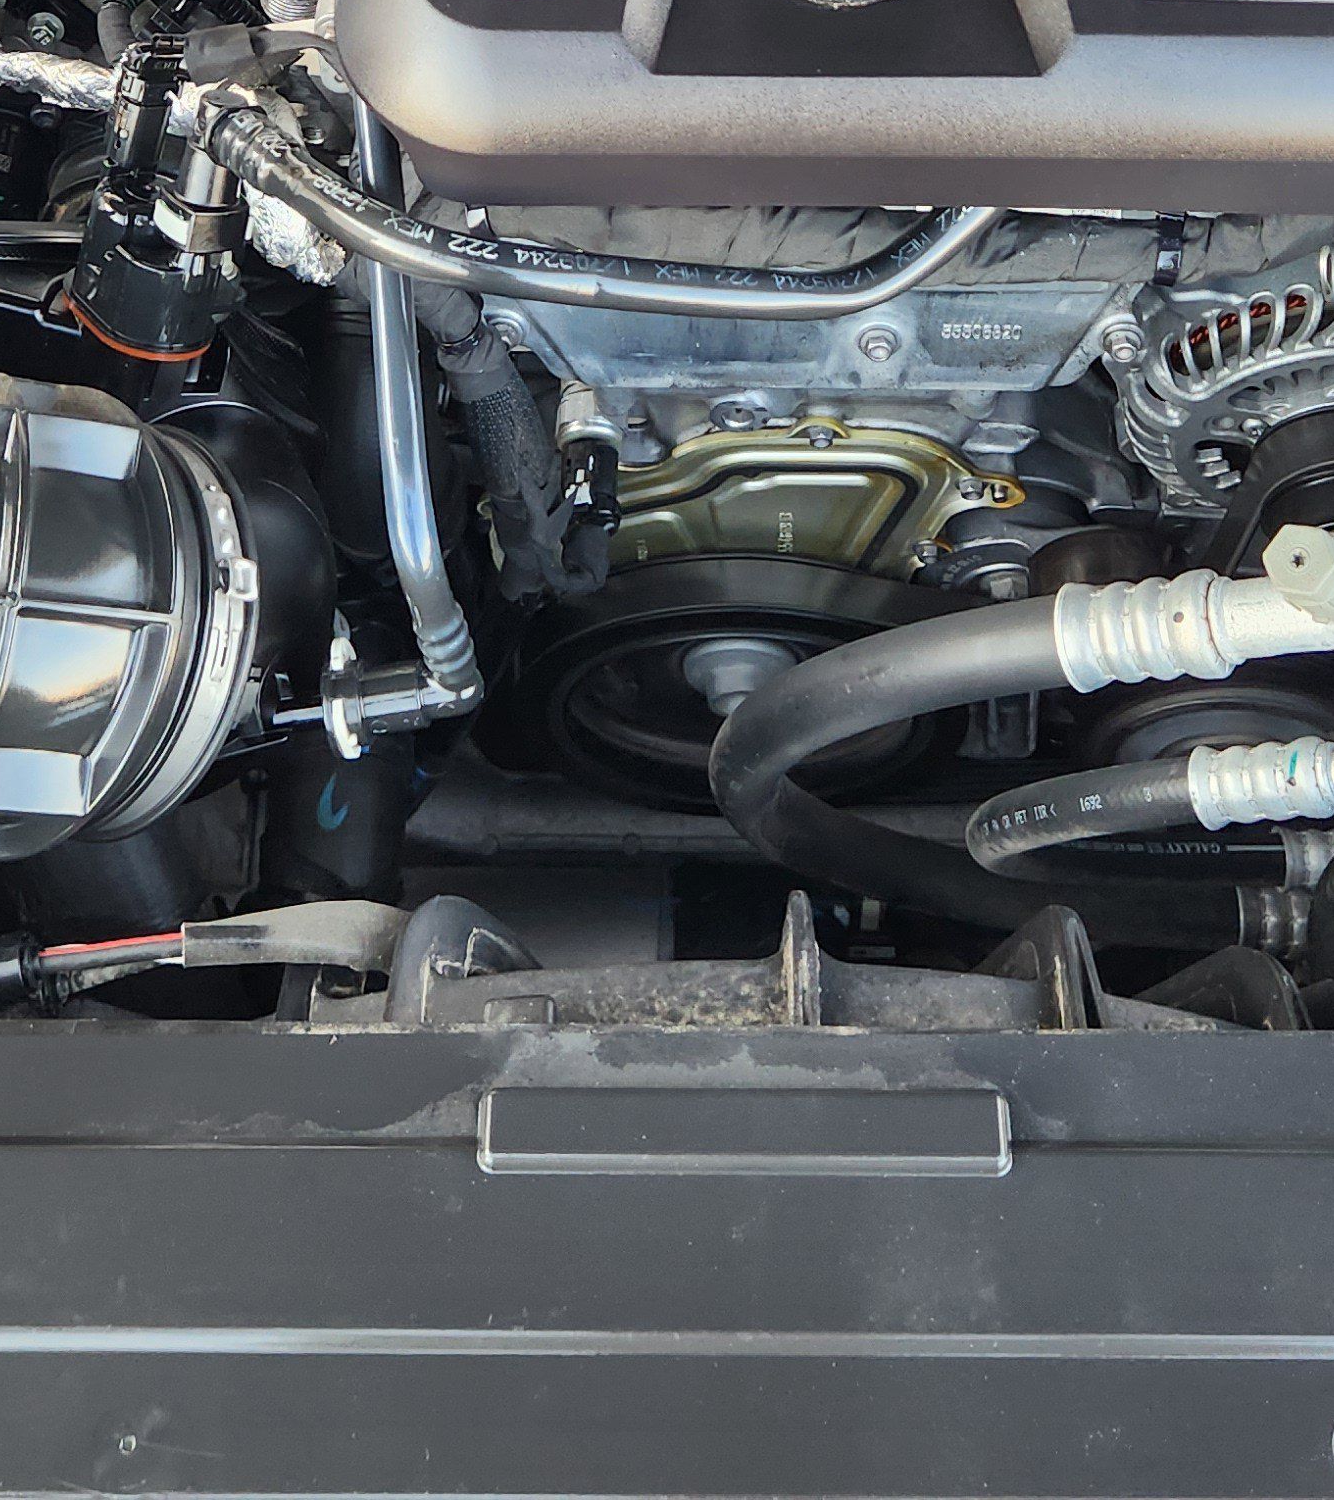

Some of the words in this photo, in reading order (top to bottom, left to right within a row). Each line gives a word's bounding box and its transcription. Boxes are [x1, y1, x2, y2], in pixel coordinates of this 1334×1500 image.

[383, 211, 435, 244] MEX
[448, 233, 498, 260] 222
[890, 232, 931, 269] MEX
